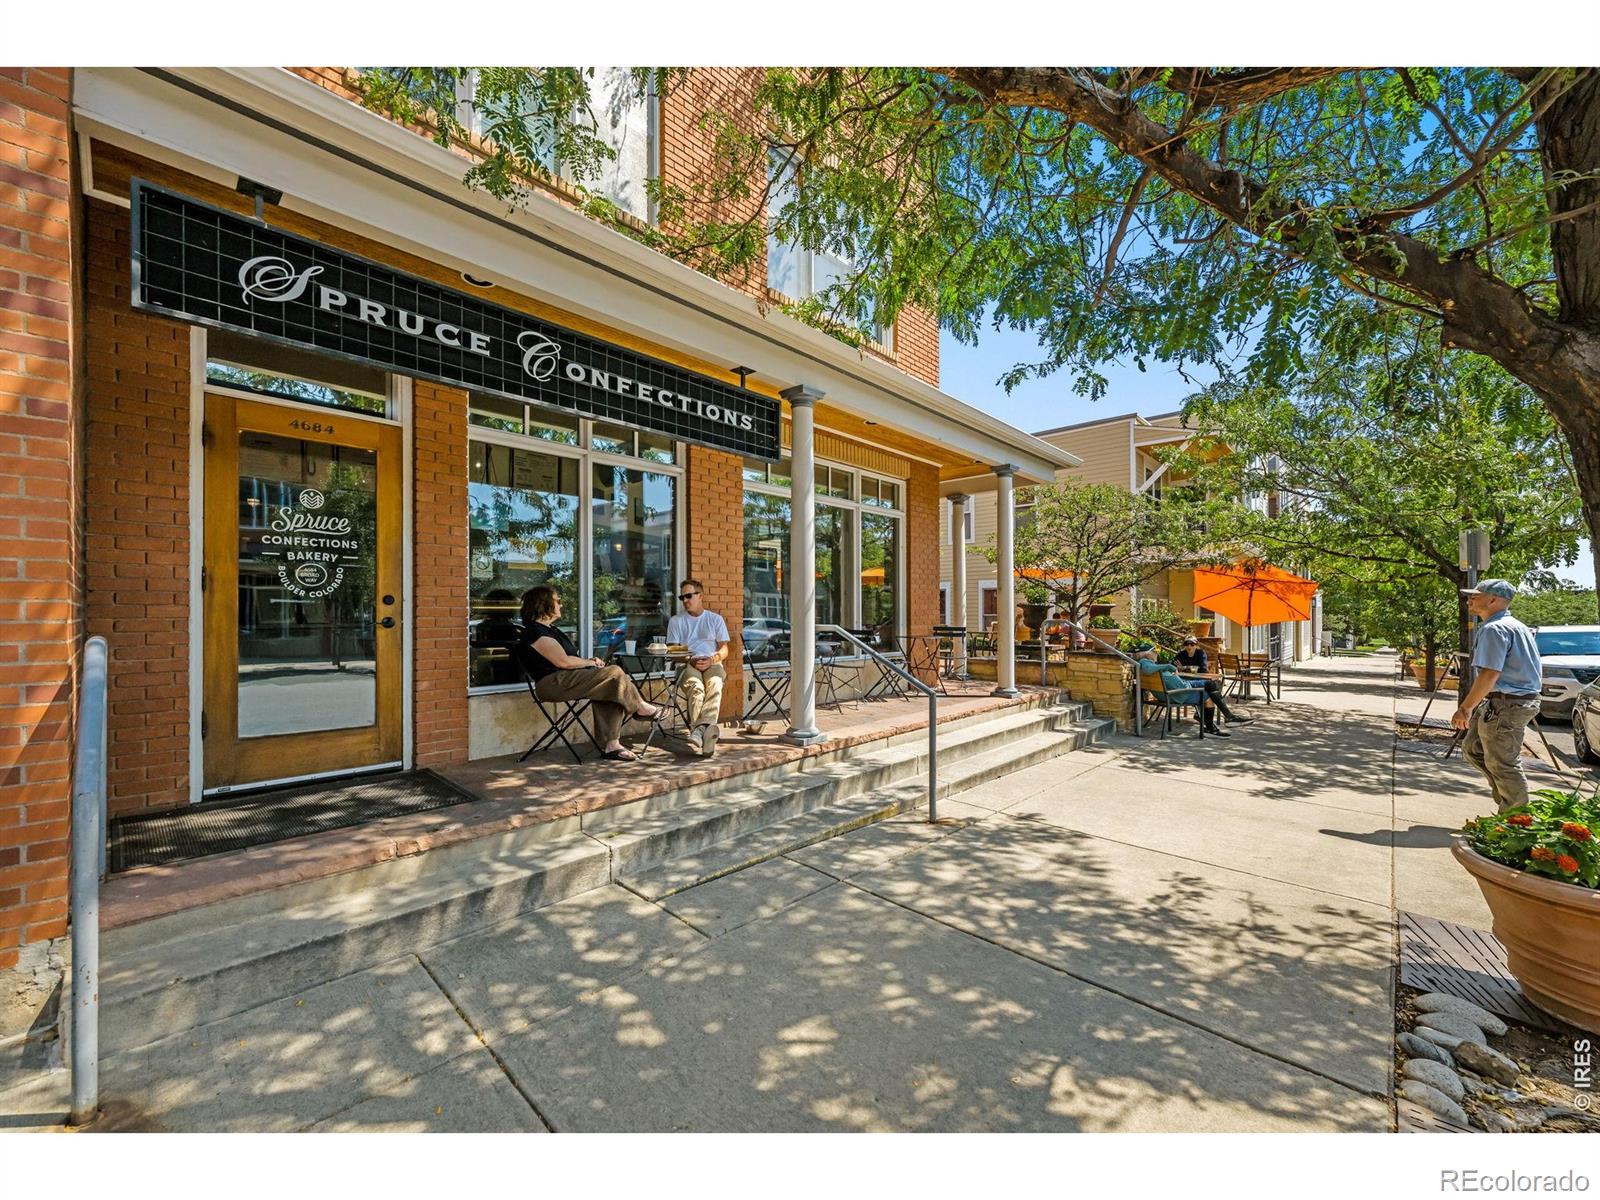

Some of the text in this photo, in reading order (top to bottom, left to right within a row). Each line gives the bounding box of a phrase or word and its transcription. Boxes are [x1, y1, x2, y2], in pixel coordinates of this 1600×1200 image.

[238, 256, 753, 430] SPRUCE CONFECTIONS
[288, 419, 335, 435] 4684
[271, 506, 351, 535] Spruce
[261, 535, 358, 549] CONFECTIONS
[287, 551, 338, 563] BAKERY
[278, 565, 344, 598] BOULDER COLORADO
